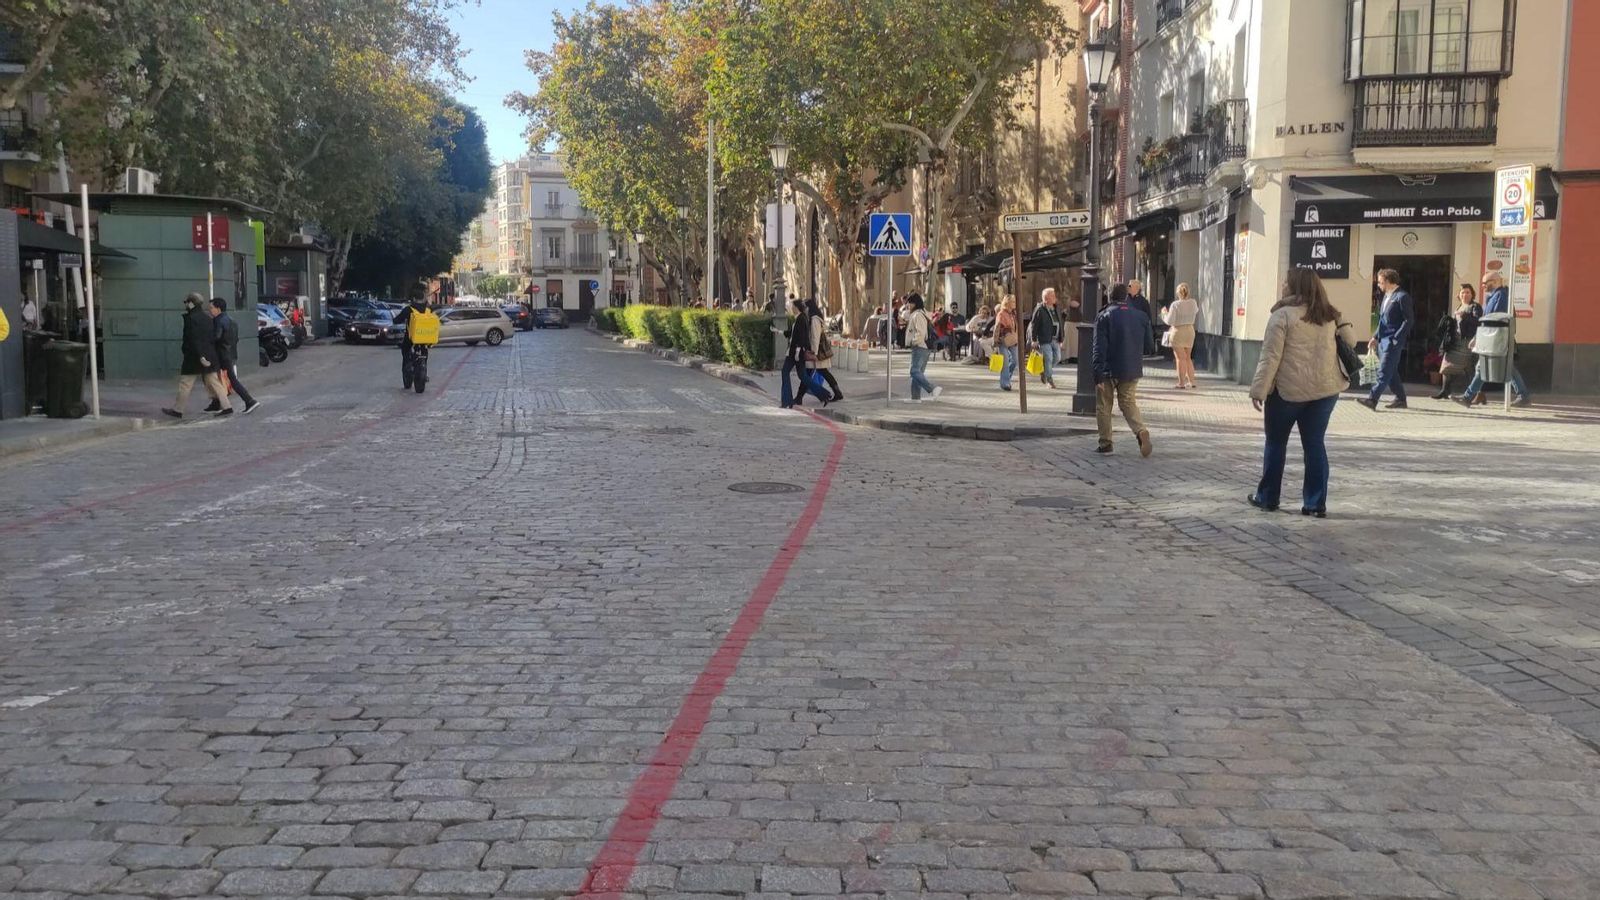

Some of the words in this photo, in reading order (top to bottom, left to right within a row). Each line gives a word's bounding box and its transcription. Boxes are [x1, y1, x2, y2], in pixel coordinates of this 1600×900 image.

[1275, 122, 1345, 138] BAILEN
[1508, 190, 1519, 198] 20
[1381, 208, 1416, 217] MARKET
[1421, 207, 1444, 216] San
[1447, 206, 1481, 216] Pablo
[1312, 229, 1345, 238] MARKET
[1315, 262, 1341, 270] Pablo
